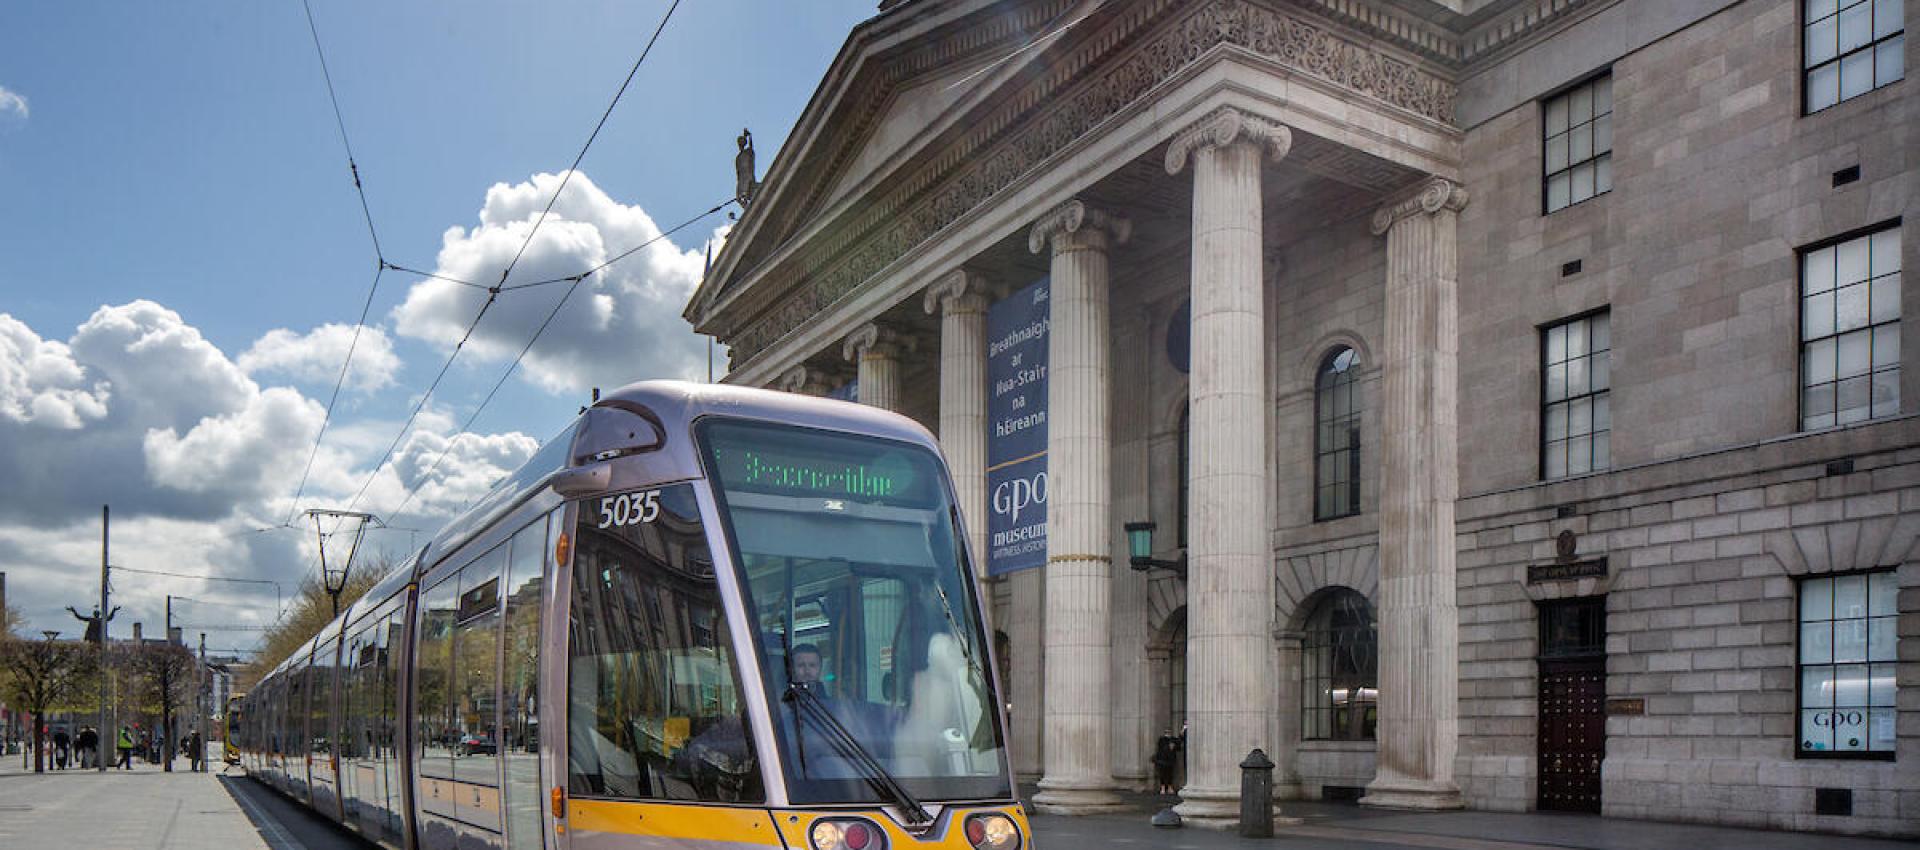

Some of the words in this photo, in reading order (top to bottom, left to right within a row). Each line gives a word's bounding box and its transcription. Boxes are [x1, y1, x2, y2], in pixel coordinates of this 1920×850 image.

[1011, 353, 1023, 366] ar
[1011, 394, 1026, 411] na
[598, 490, 661, 528] 5035
[993, 521, 1048, 547] museum
